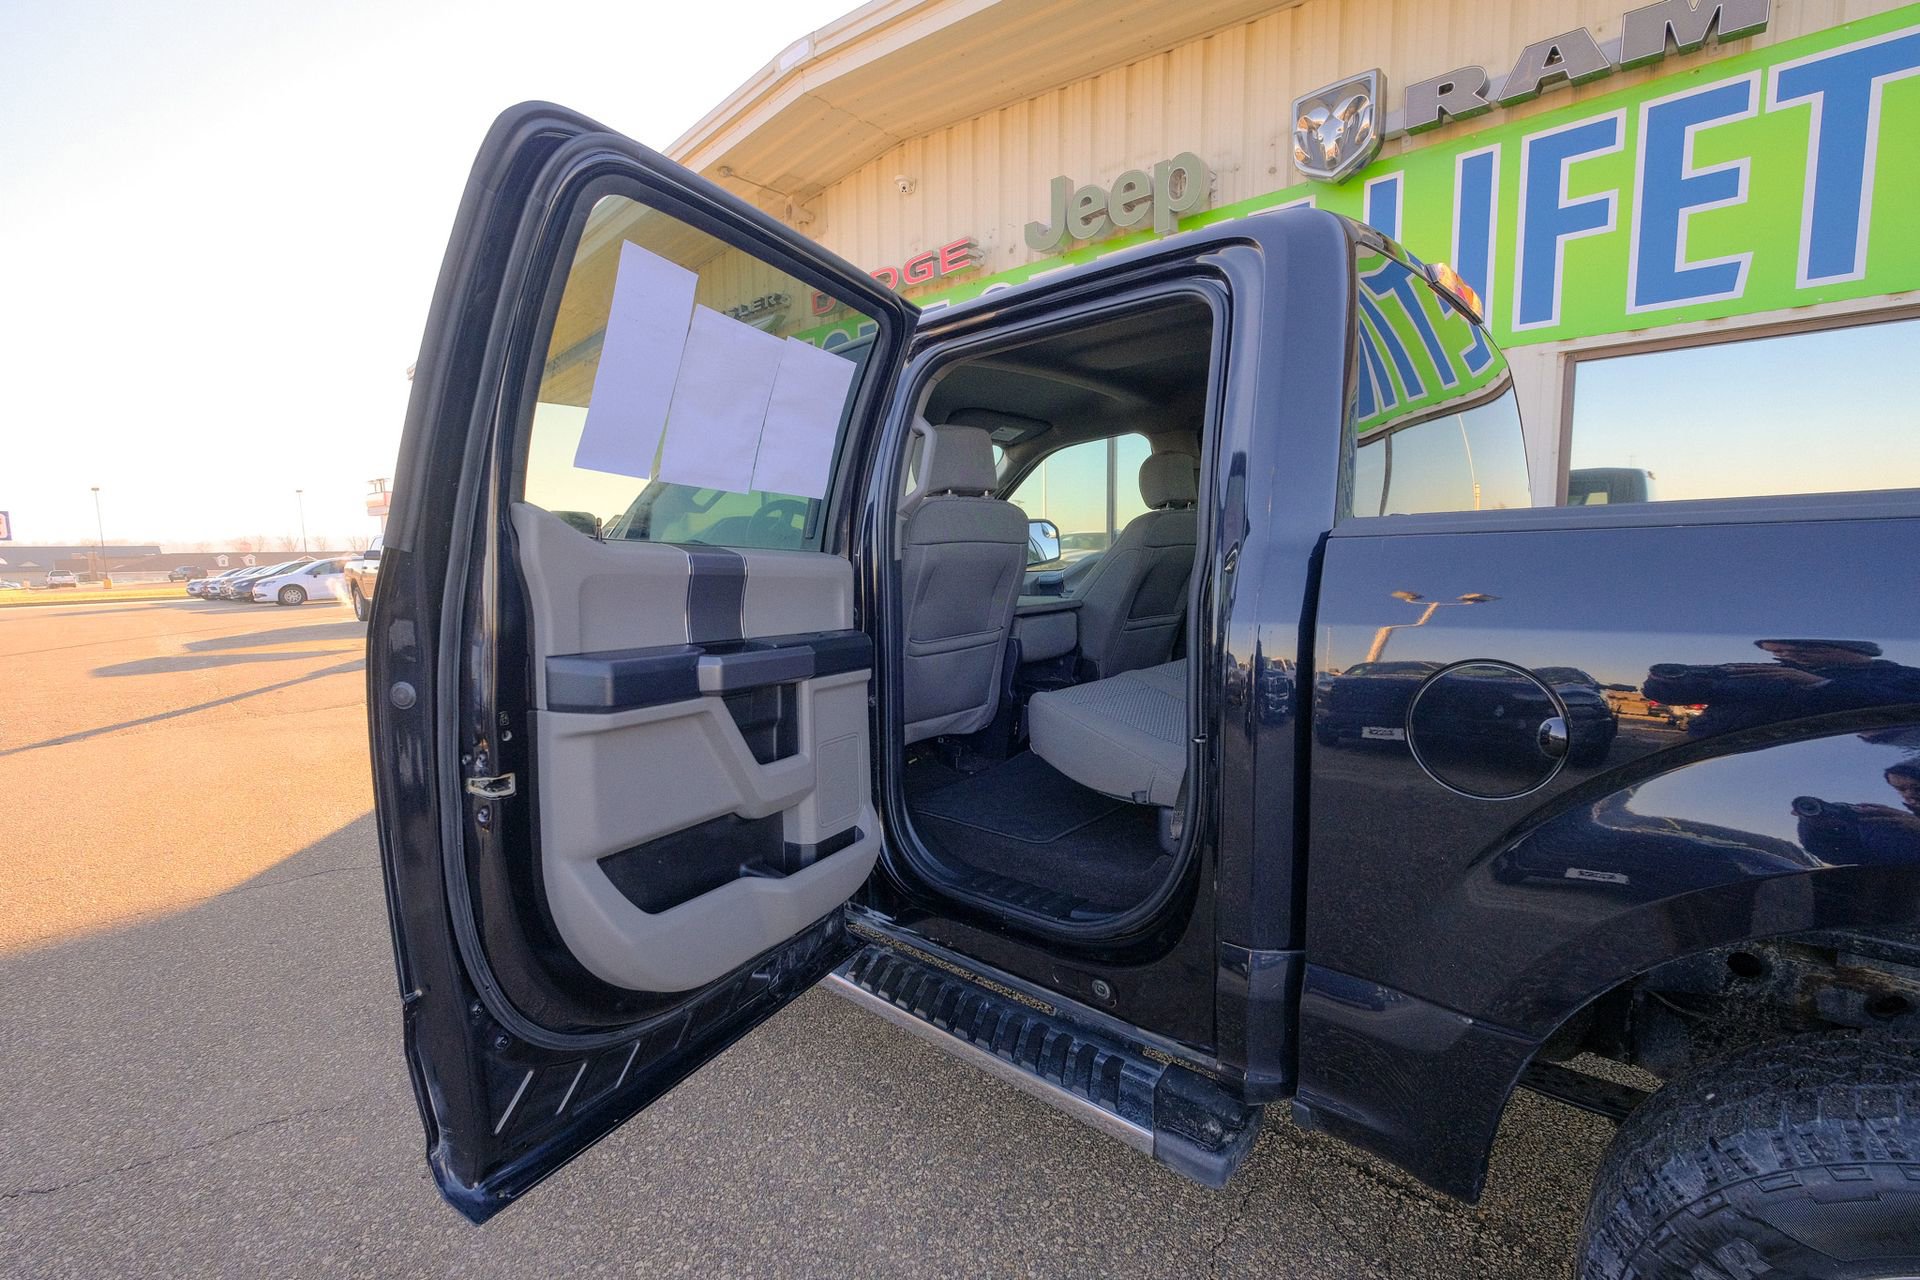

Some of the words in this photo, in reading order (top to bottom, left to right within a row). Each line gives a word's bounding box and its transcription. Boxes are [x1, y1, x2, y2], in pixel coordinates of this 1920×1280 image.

[1403, 0, 1770, 136] RAM
[1024, 151, 1212, 253] Jeep
[811, 237, 976, 316] DDGE
